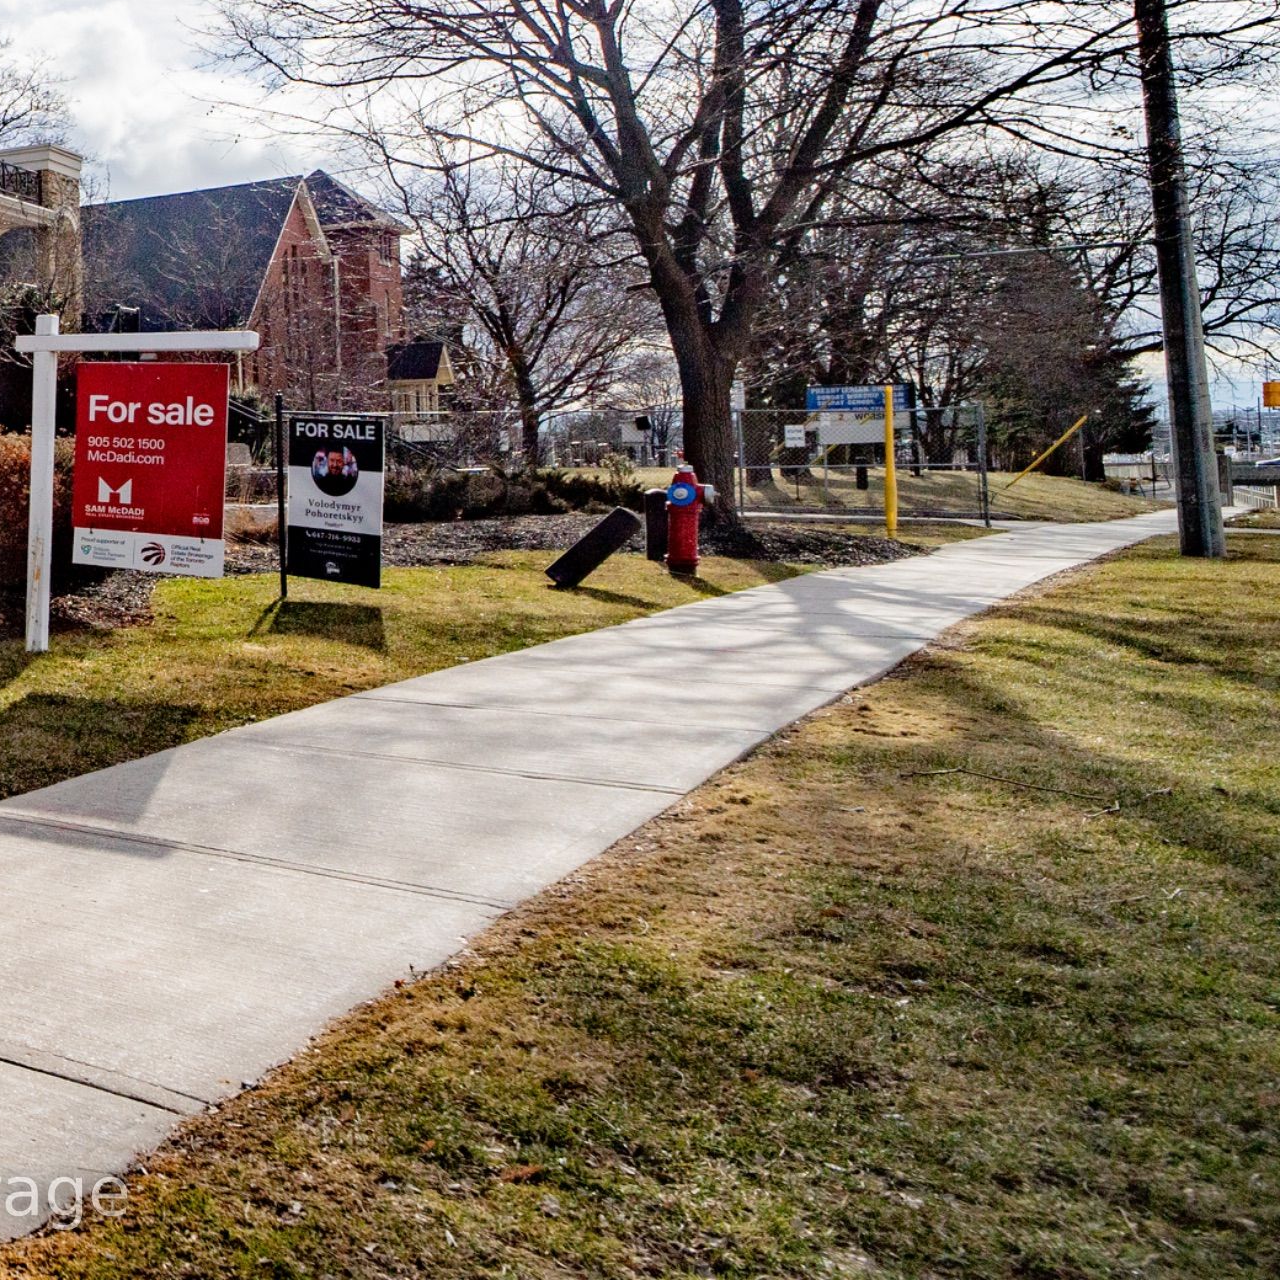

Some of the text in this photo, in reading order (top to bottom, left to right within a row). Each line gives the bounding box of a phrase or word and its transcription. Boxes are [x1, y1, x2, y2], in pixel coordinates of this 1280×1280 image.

[88, 394, 215, 427] For sale
[295, 422, 376, 441] FOR SALE
[87, 436, 165, 450] 905 502 1500
[87, 450, 165, 465] McDadi.com
[85, 504, 145, 516] SAM McDADI
[308, 498, 362, 513] Volodymyr
[304, 507, 364, 523] Pohoretskyy
